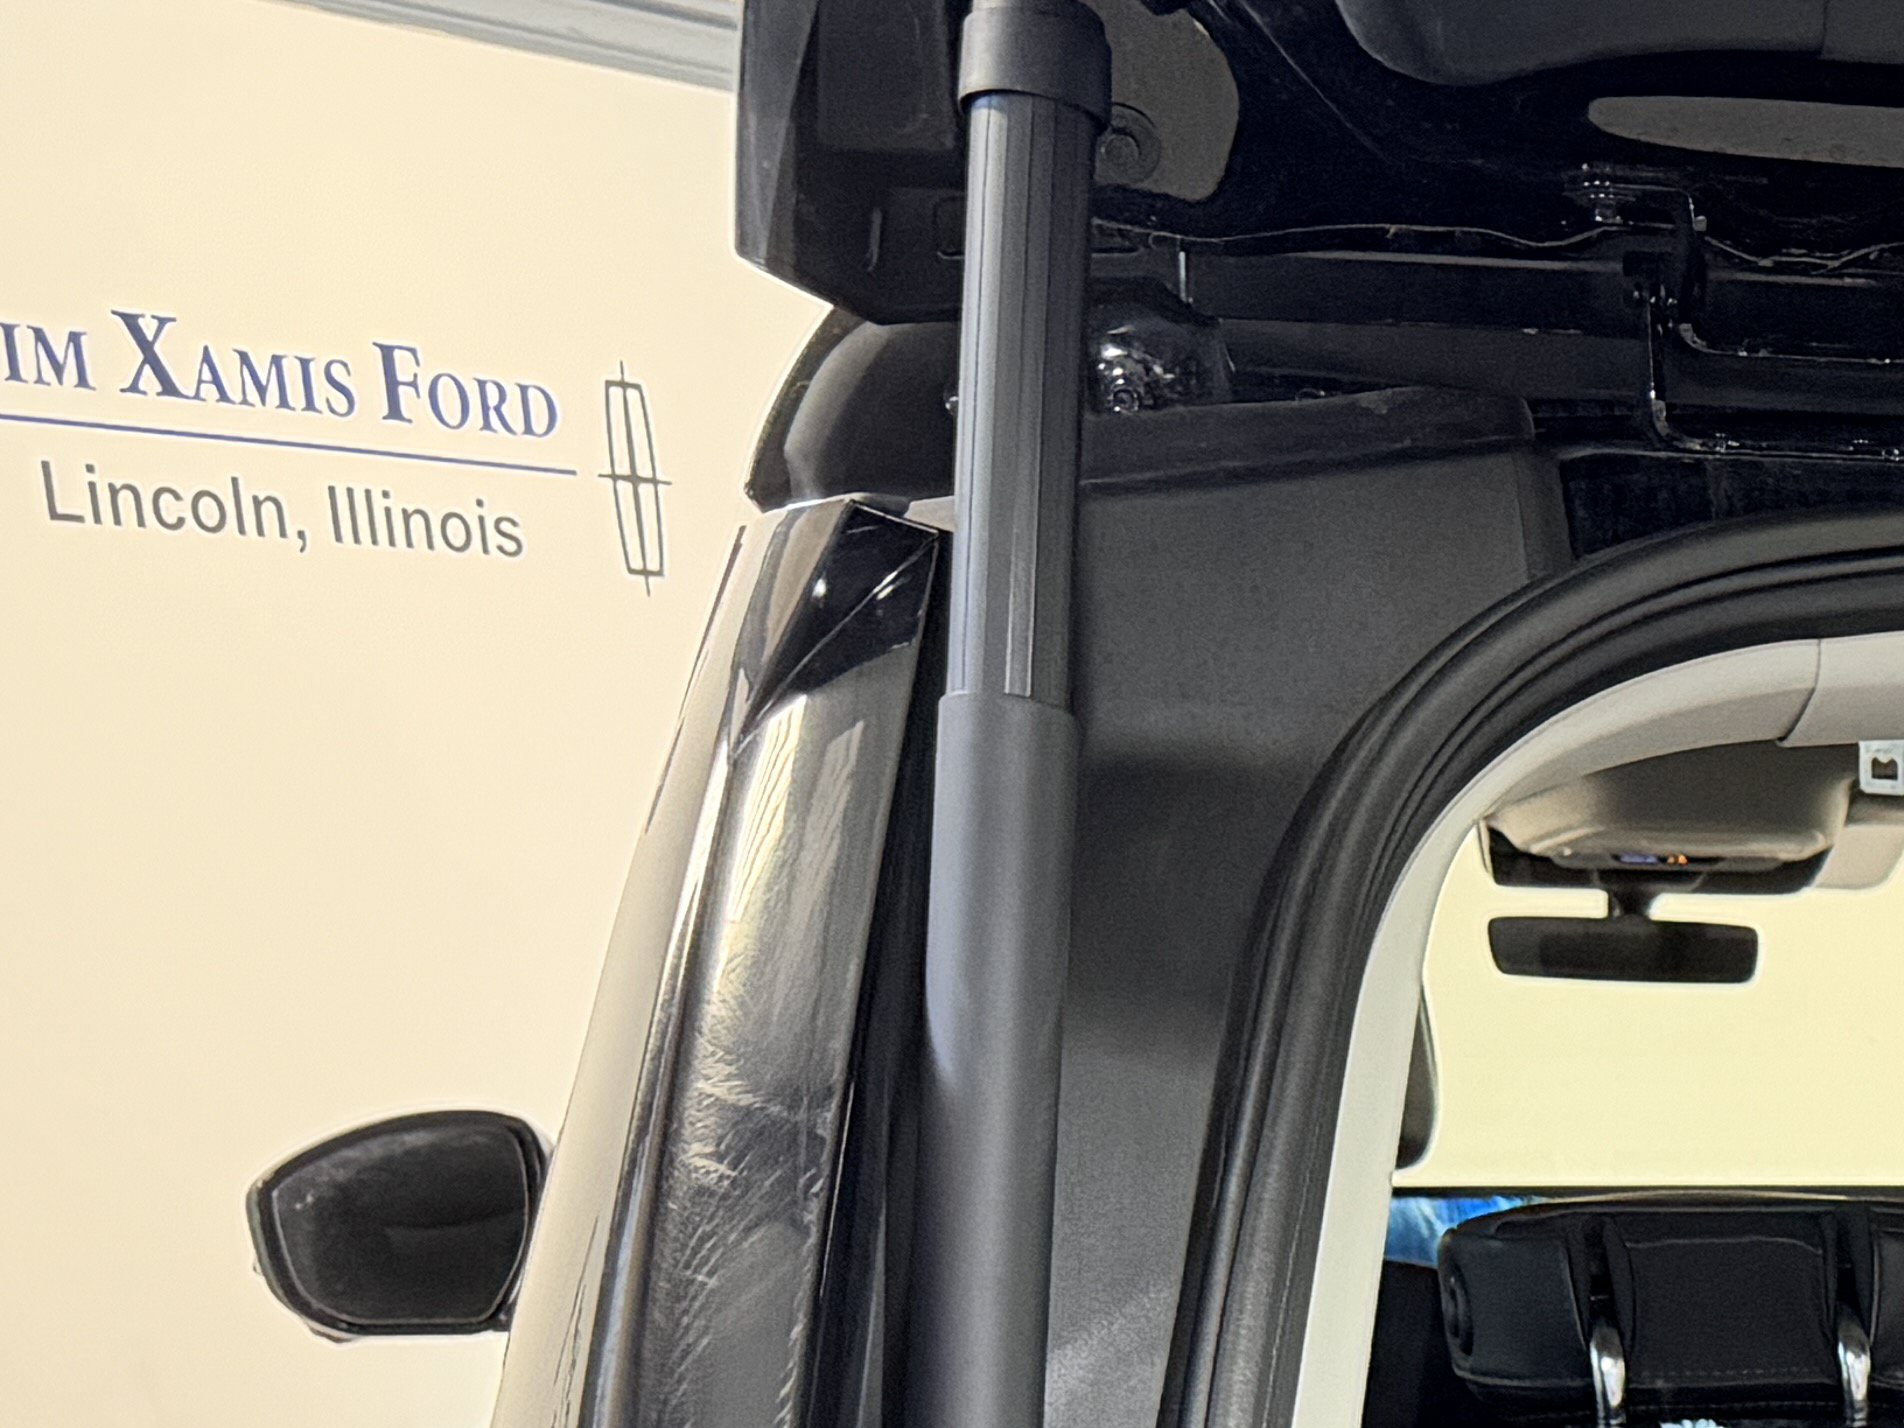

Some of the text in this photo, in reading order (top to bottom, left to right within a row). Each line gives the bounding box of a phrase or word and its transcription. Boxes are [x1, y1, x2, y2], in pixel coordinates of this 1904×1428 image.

[0, 309, 558, 438] IM XAMIS FORD
[41, 460, 524, 558] Lincoln, Illinois
